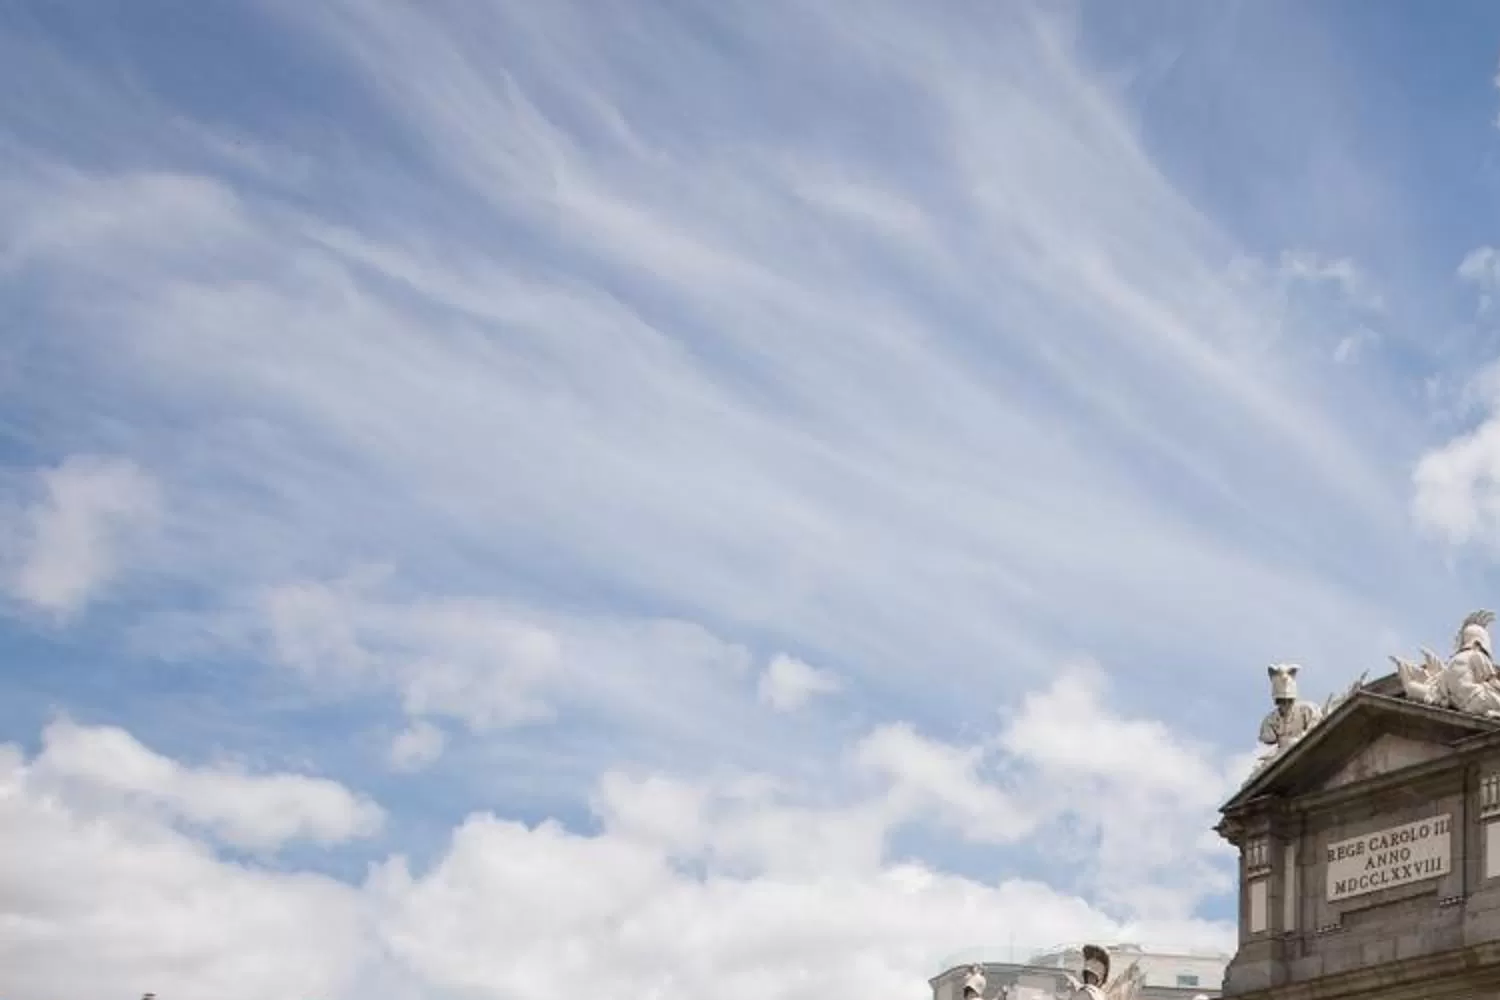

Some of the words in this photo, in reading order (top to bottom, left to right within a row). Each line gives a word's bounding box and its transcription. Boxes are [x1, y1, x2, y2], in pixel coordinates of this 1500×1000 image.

[1327, 842, 1365, 862] REGE
[1369, 824, 1430, 851] CAROLO
[1364, 847, 1411, 870] ANNO
[1334, 856, 1442, 894] MDCCLXXVIII
